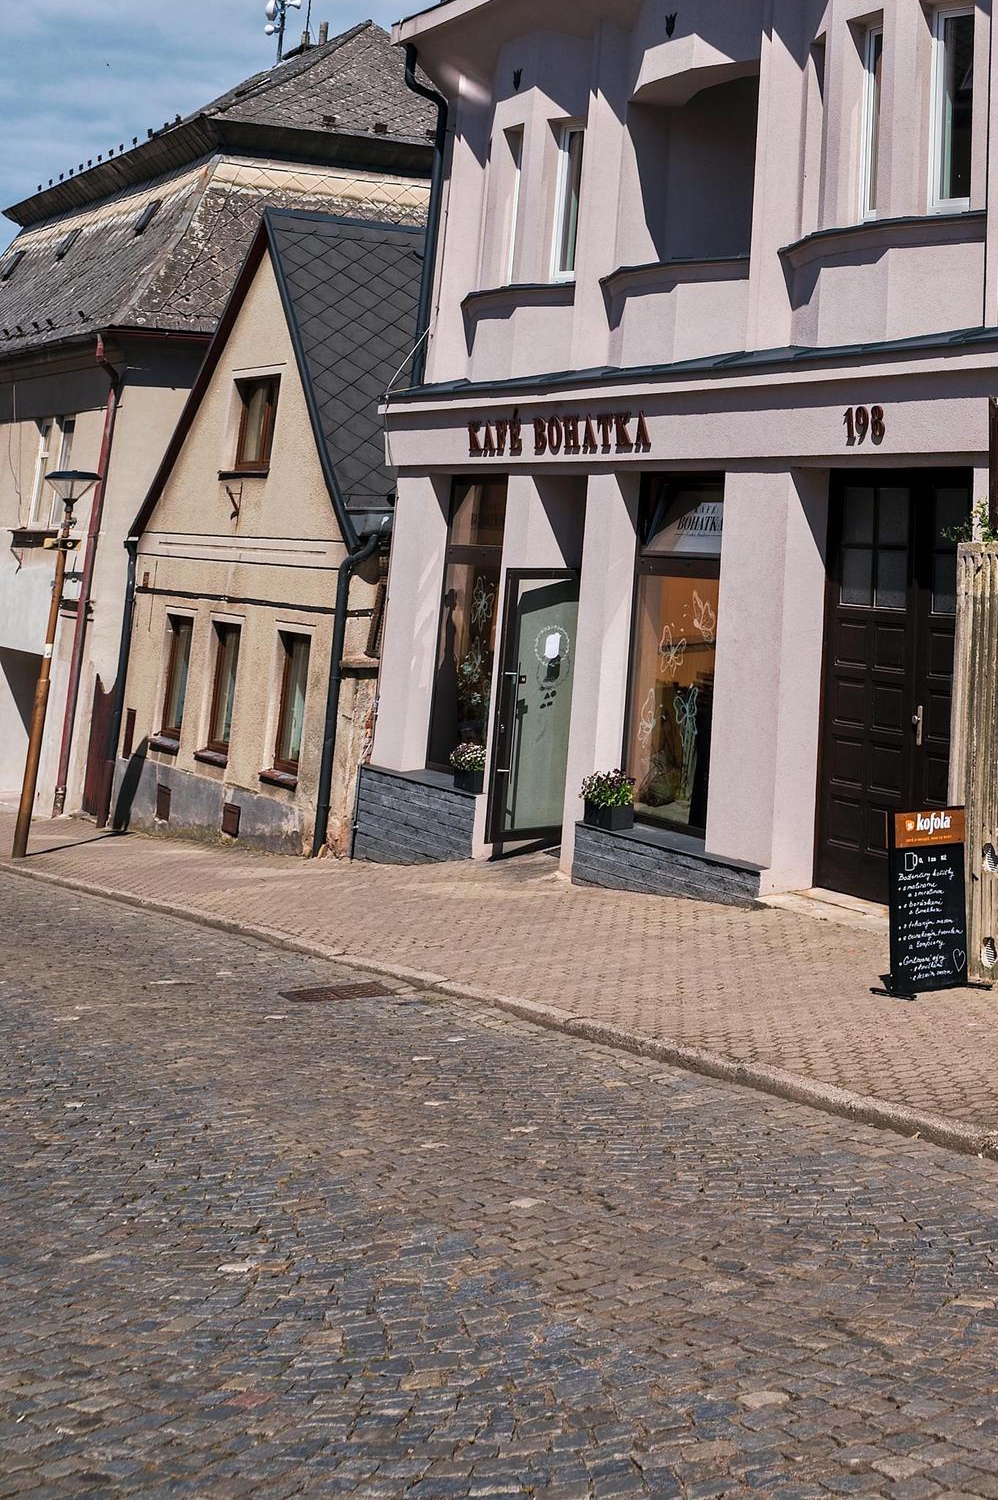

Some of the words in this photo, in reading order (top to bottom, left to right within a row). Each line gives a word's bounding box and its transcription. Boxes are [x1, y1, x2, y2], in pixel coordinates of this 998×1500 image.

[468, 407, 522, 454] KAFÉ
[533, 411, 651, 453] BOHATKA
[843, 406, 885, 444] 198
[916, 811, 951, 835] kofola
